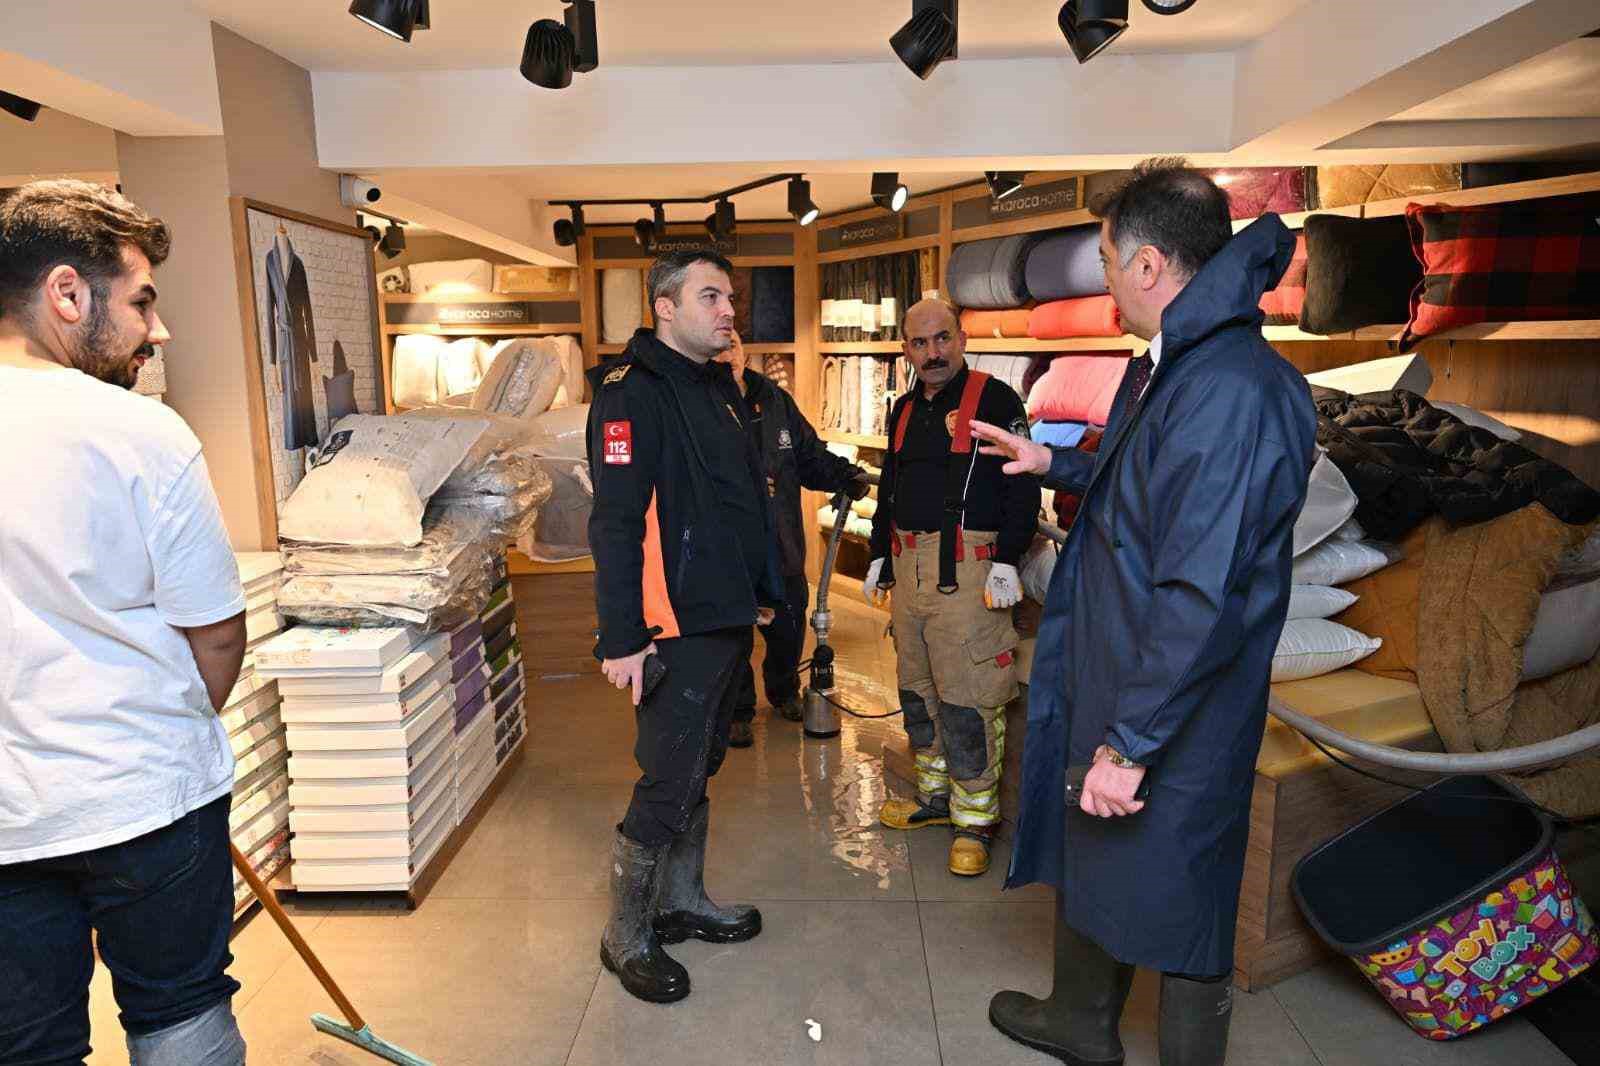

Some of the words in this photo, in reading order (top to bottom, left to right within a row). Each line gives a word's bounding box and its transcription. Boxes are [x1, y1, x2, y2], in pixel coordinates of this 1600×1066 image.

[607, 440, 628, 454] 112
[1433, 918, 1498, 977] TOY
[1469, 924, 1536, 982] BOX
